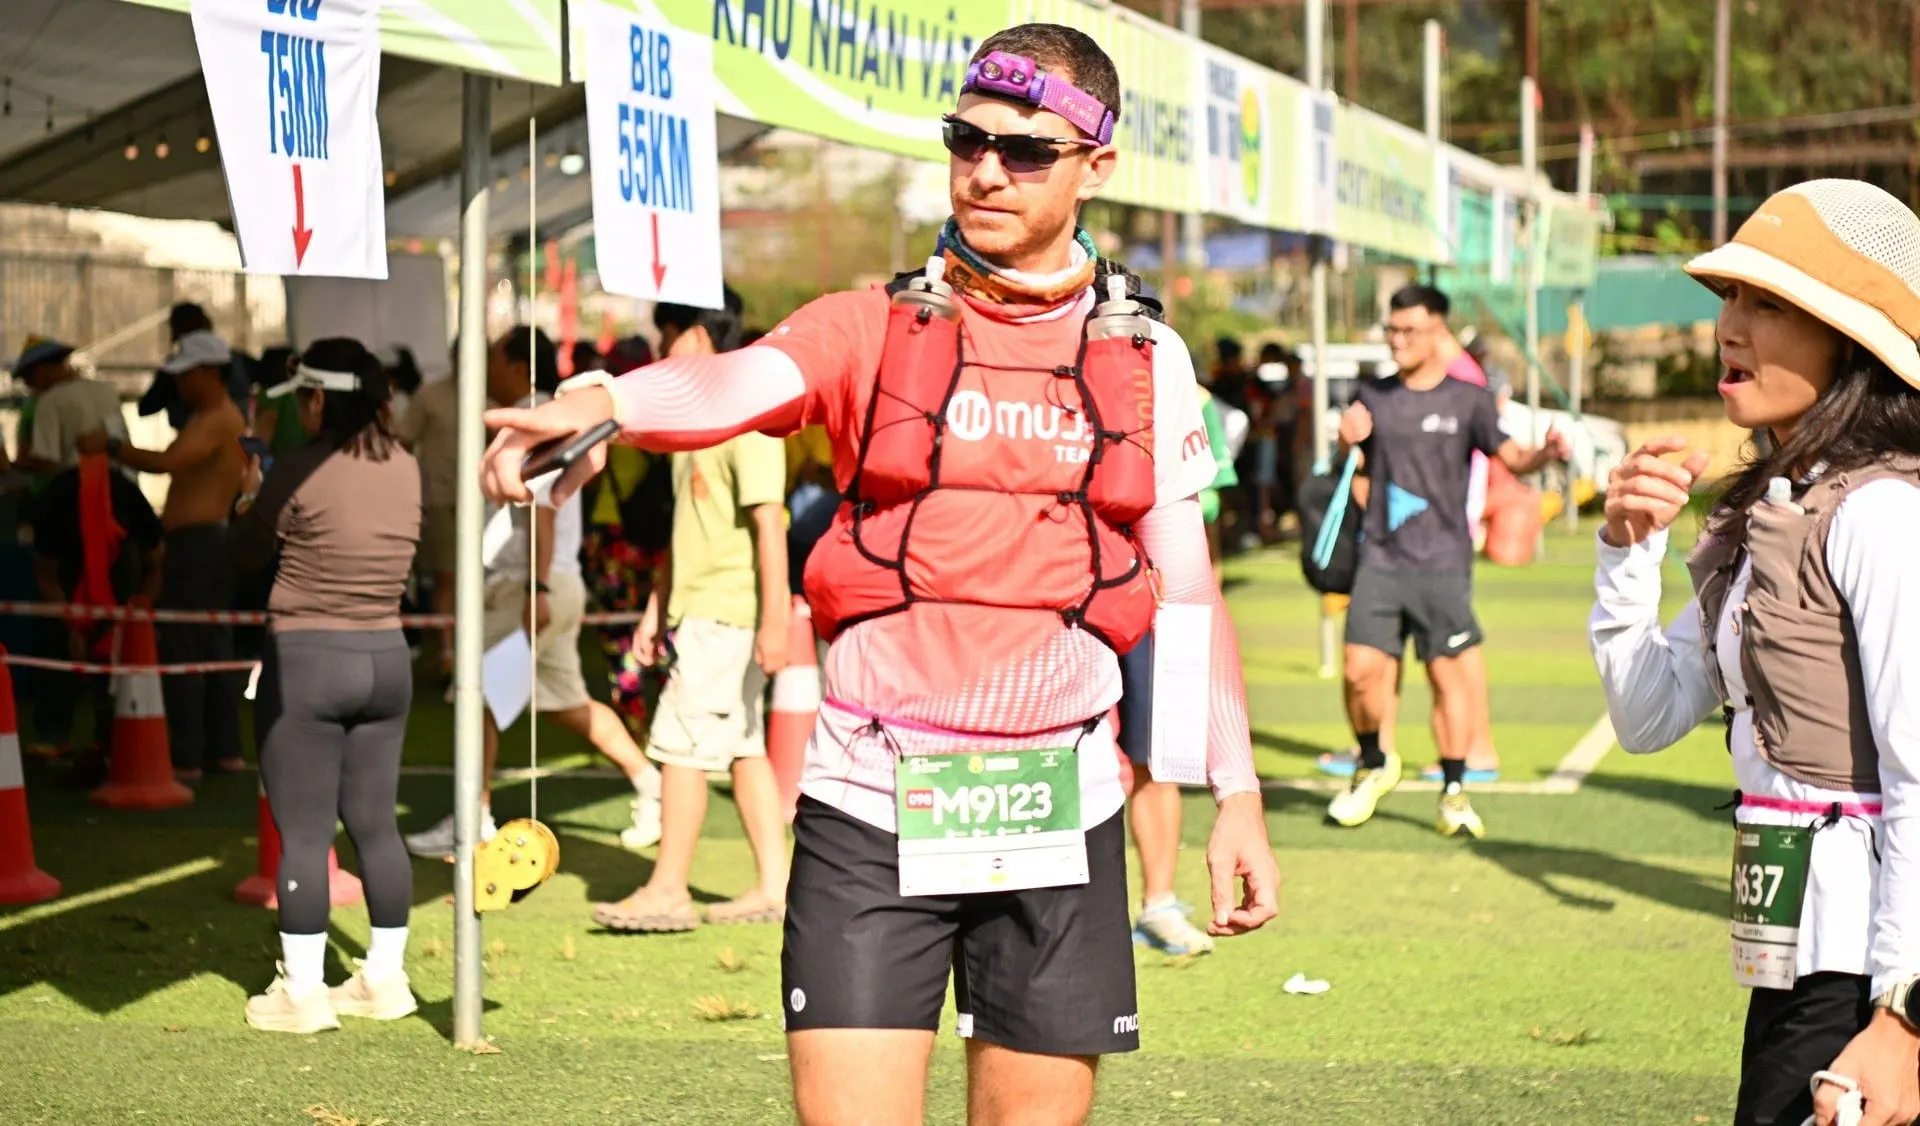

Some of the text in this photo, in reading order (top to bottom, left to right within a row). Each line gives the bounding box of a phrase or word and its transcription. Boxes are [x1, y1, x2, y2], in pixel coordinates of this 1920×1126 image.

[261, 30, 329, 160] 75KM
[629, 23, 673, 100] BIB
[617, 103, 694, 213] 55KM
[932, 781, 1052, 825] M9123
